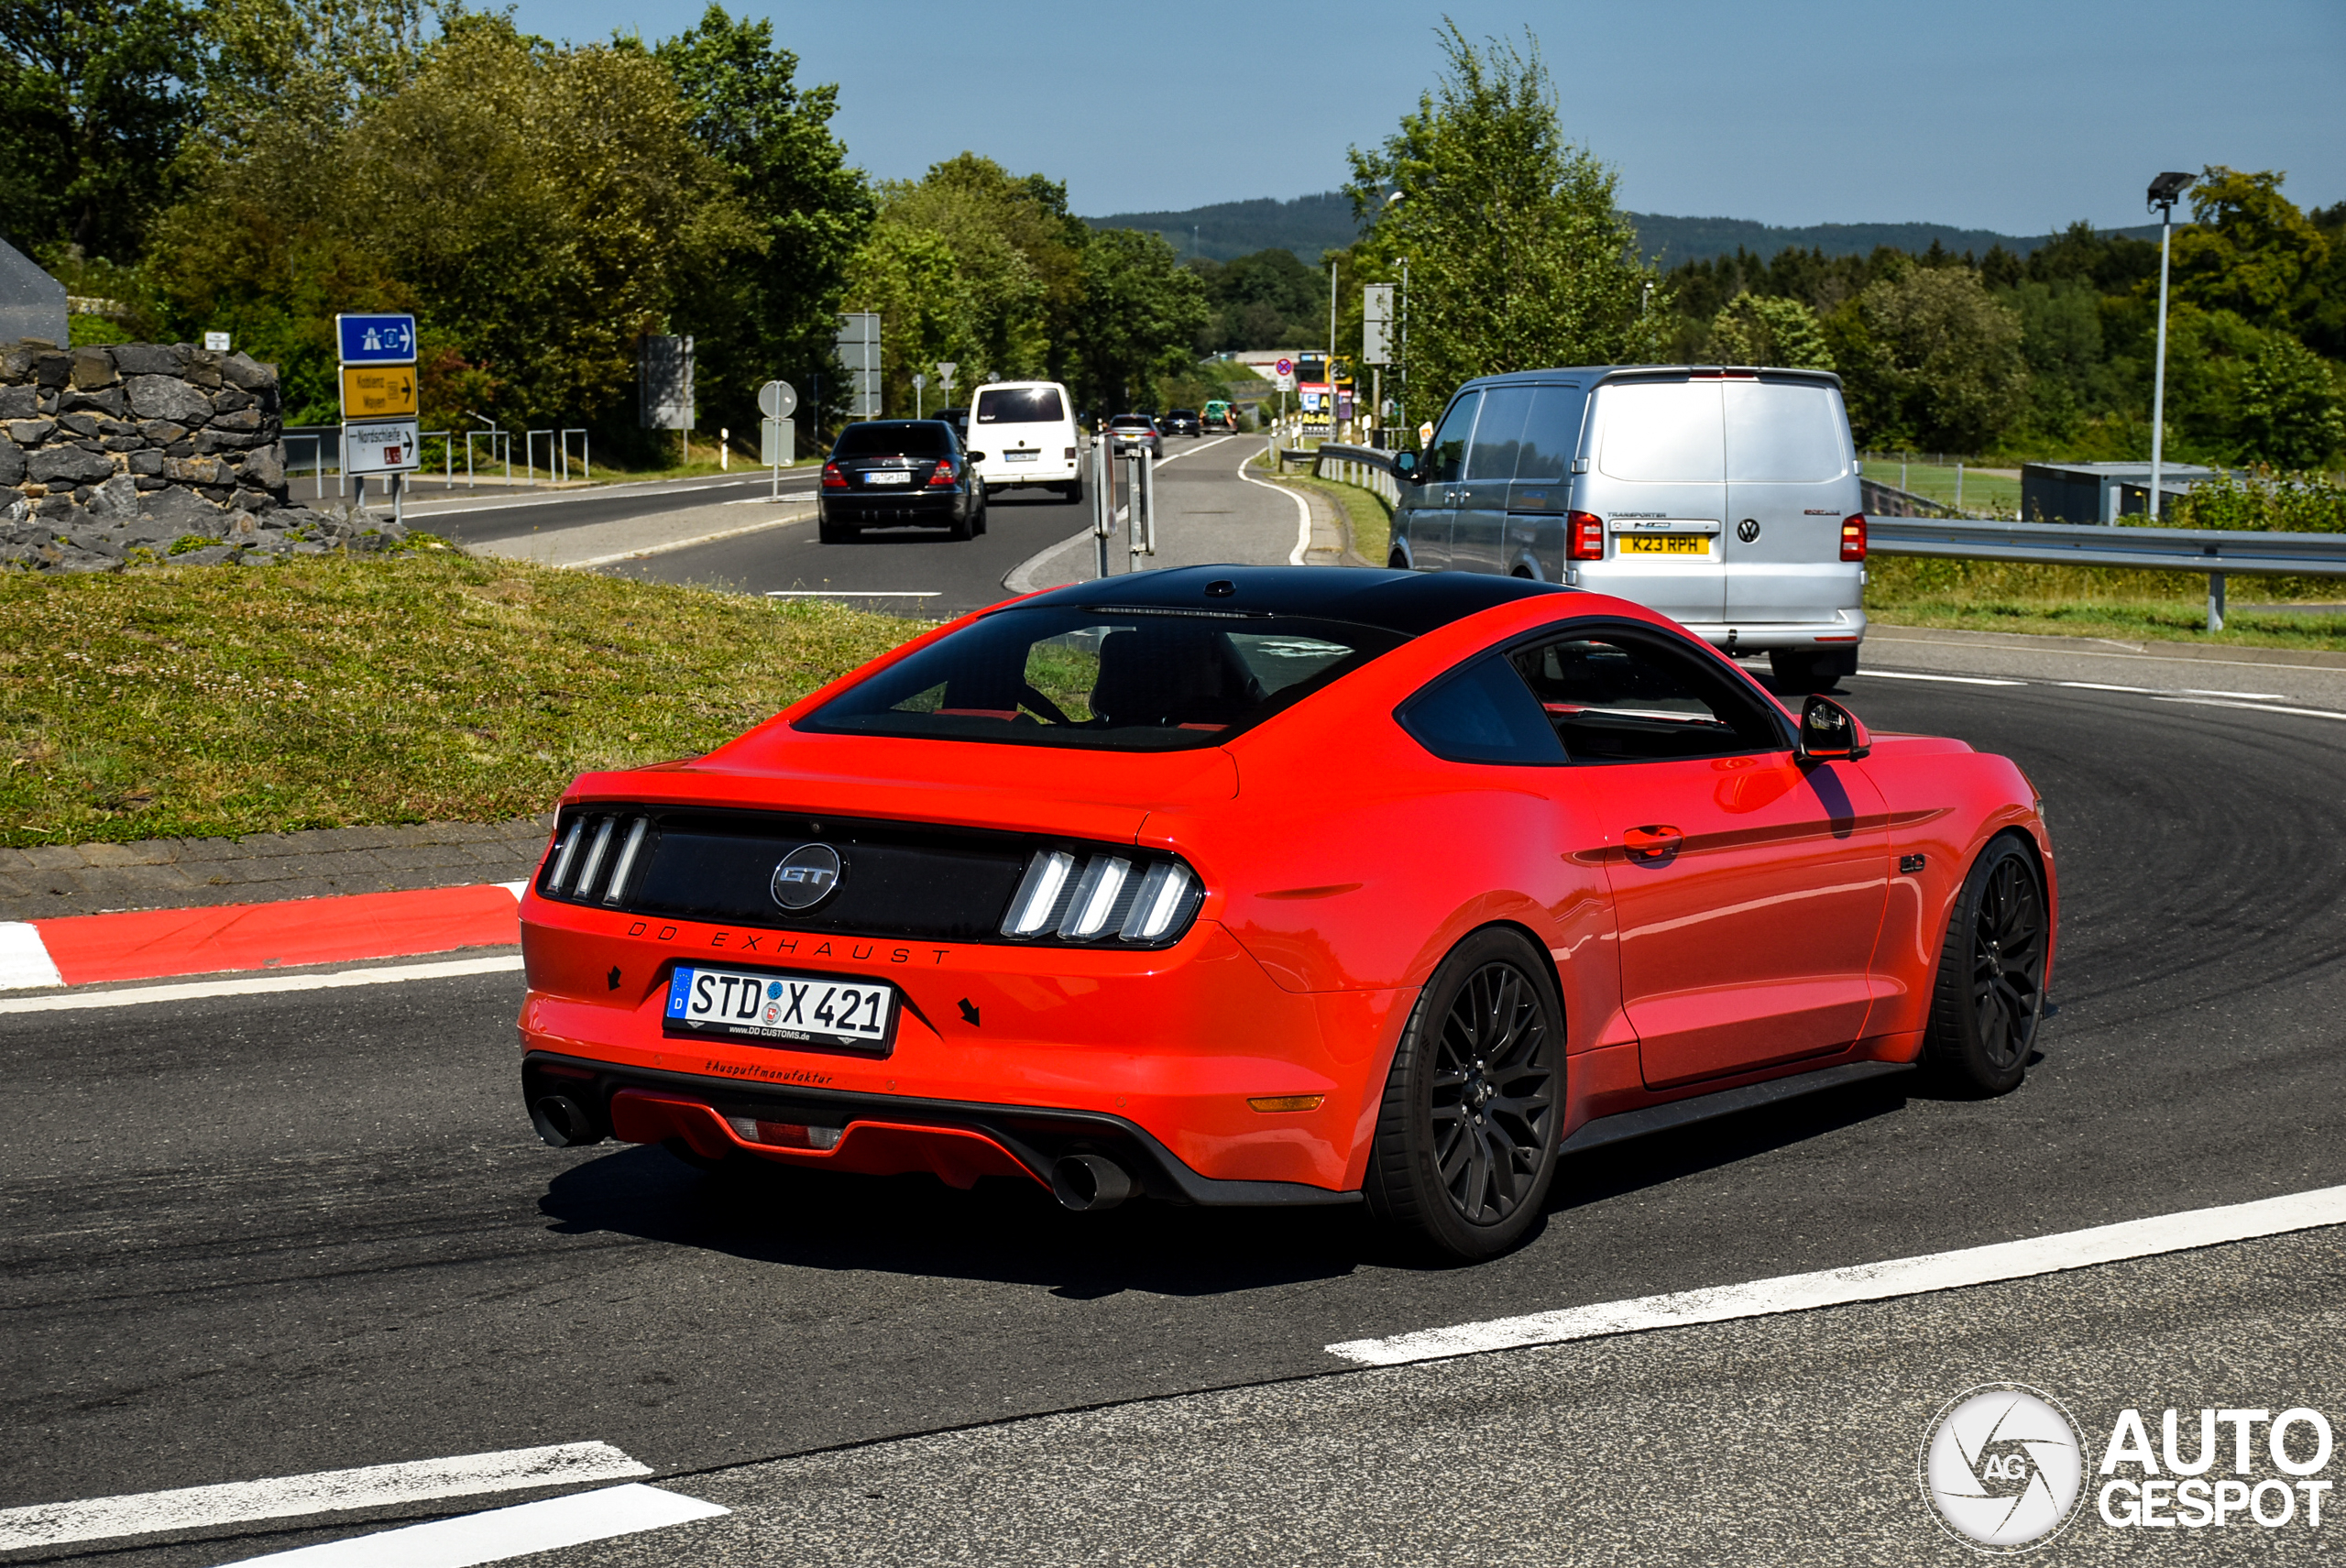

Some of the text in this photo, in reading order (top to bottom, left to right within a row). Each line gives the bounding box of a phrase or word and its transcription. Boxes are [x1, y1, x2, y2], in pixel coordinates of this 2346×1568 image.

[356, 375, 385, 389] Koblenz
[363, 395, 386, 411] Mayen
[1632, 536, 1698, 552] K23 RPH
[780, 866, 834, 885] GT
[628, 922, 950, 965] DD EXHAUST
[674, 998, 683, 1010] D
[692, 975, 882, 1034] STD X 421
[705, 1059, 833, 1084] #Auspuffmanufaktur
